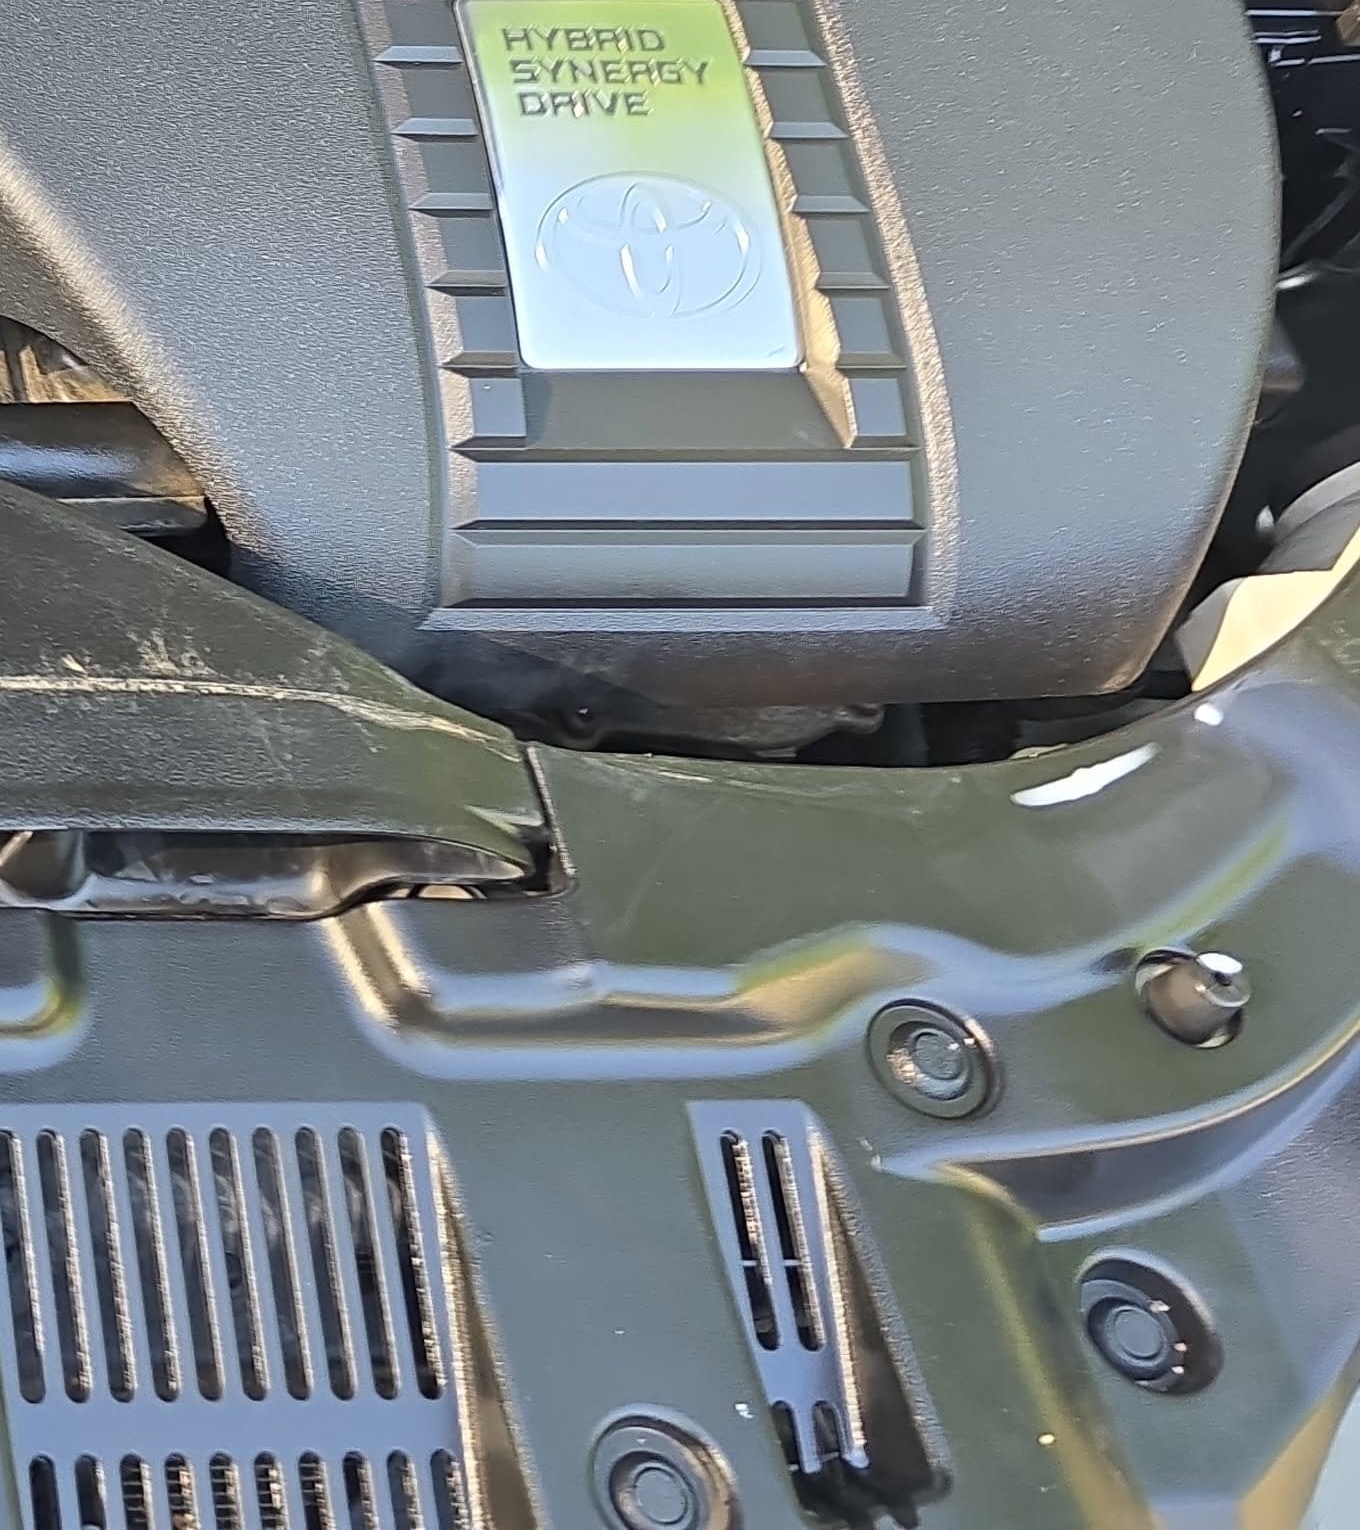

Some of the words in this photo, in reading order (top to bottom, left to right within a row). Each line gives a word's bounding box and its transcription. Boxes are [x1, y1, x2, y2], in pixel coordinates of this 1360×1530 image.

[502, 27, 665, 52] HYBRID
[509, 59, 711, 85] SYNERGY
[518, 91, 652, 118] DRIVE
